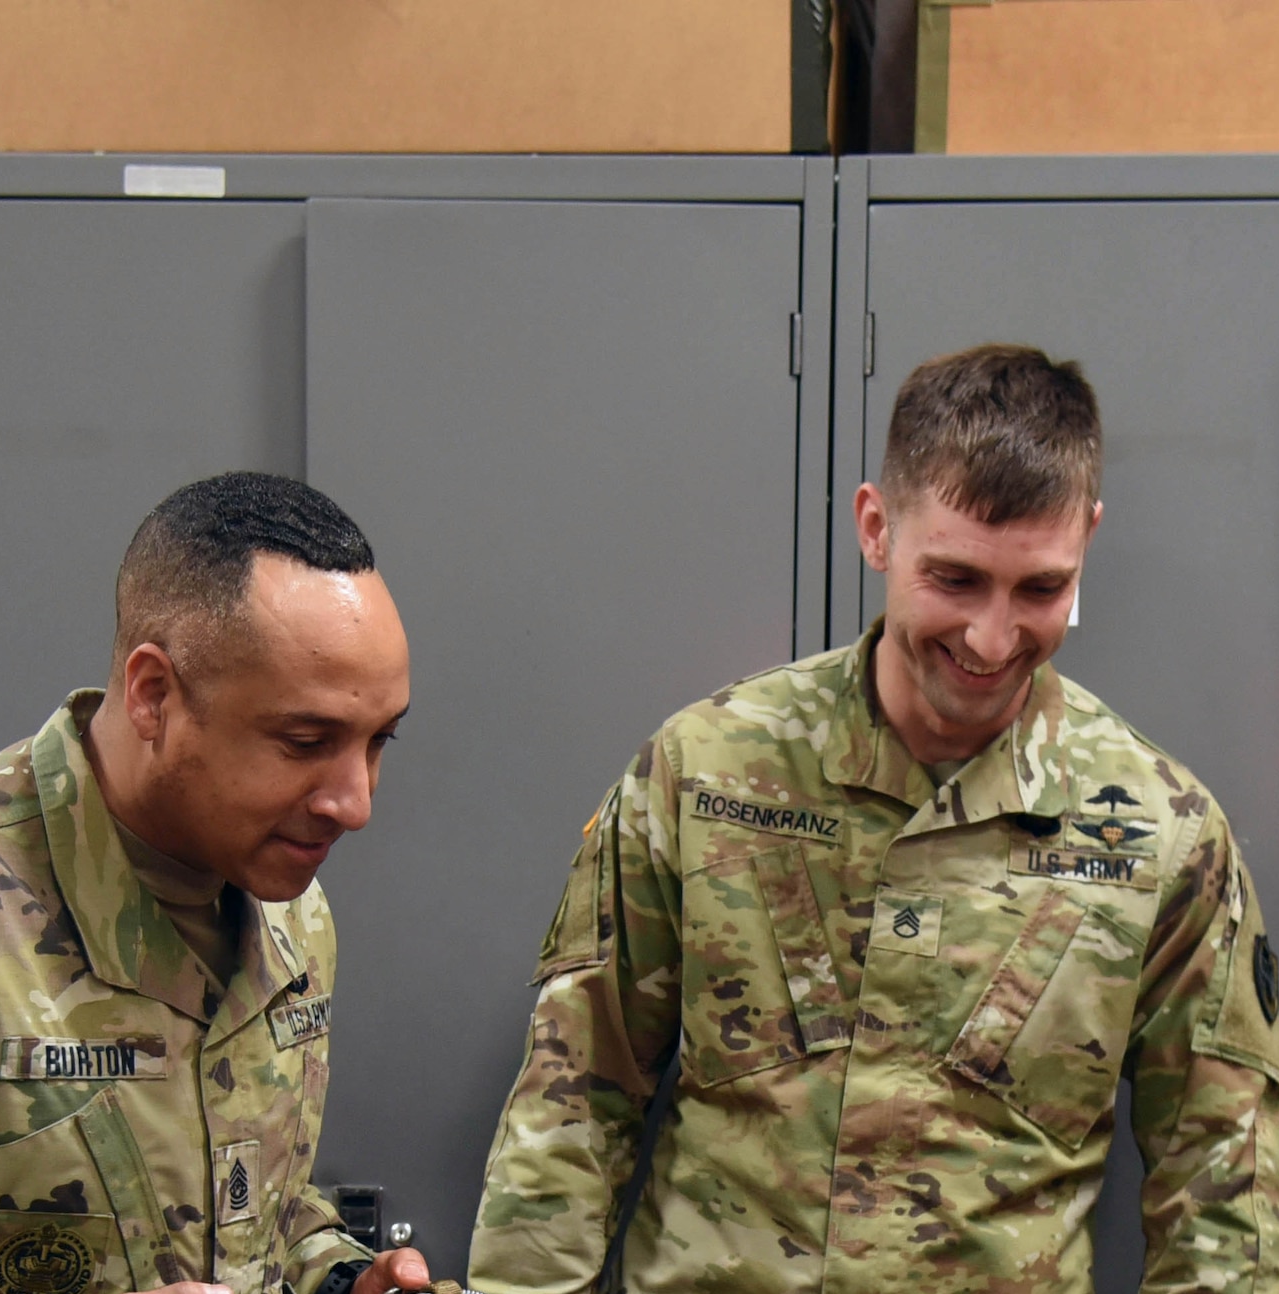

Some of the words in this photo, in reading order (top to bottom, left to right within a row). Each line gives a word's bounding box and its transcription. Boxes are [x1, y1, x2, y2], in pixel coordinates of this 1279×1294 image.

[695, 791, 840, 838] ROSENKRANZ
[1074, 855, 1136, 882] ARMY
[45, 1044, 136, 1077] BURTON
